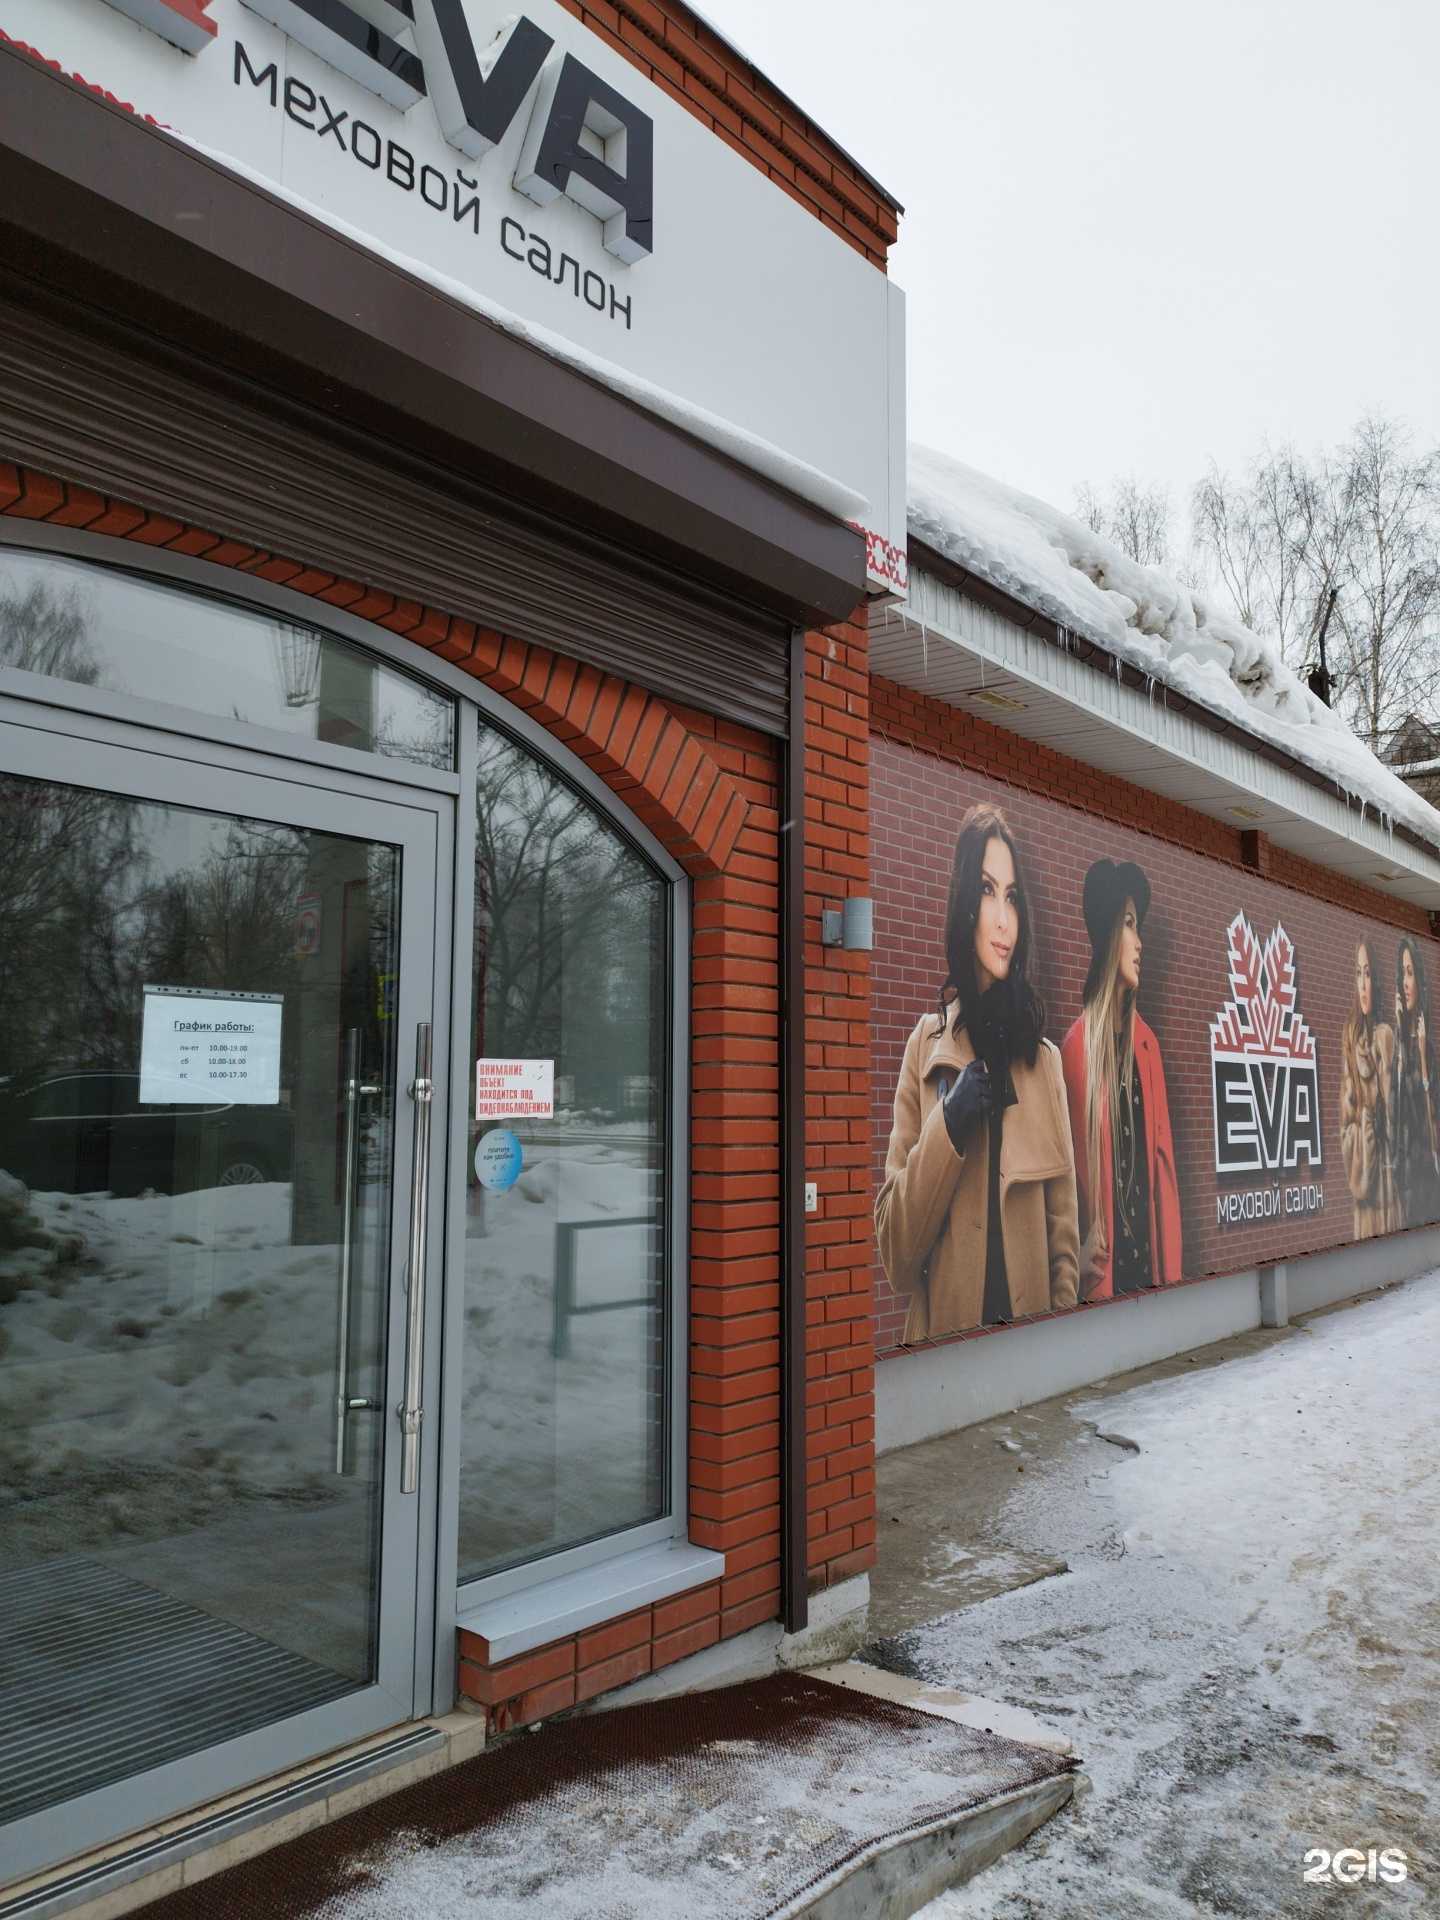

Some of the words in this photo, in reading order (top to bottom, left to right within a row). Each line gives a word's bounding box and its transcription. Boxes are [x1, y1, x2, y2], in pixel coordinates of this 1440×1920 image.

[233, 40, 481, 235] меховой
[499, 215, 632, 330] салон
[174, 1020, 212, 1033] График
[214, 1021, 255, 1033] работы:
[479, 1064, 522, 1076] ВНИМАНИЕ
[479, 1077, 505, 1087] ОБЪЕКТ
[479, 1089, 518, 1100] НАХОДИТСЯ
[520, 1089, 534, 1100] ПОД
[479, 1102, 551, 1115] ВИДЕОНАБЛЮДЕНИЕМ
[1212, 1057, 1322, 1172] EVA
[1216, 1181, 1281, 1224] меховой
[1285, 1184, 1325, 1213] салон
